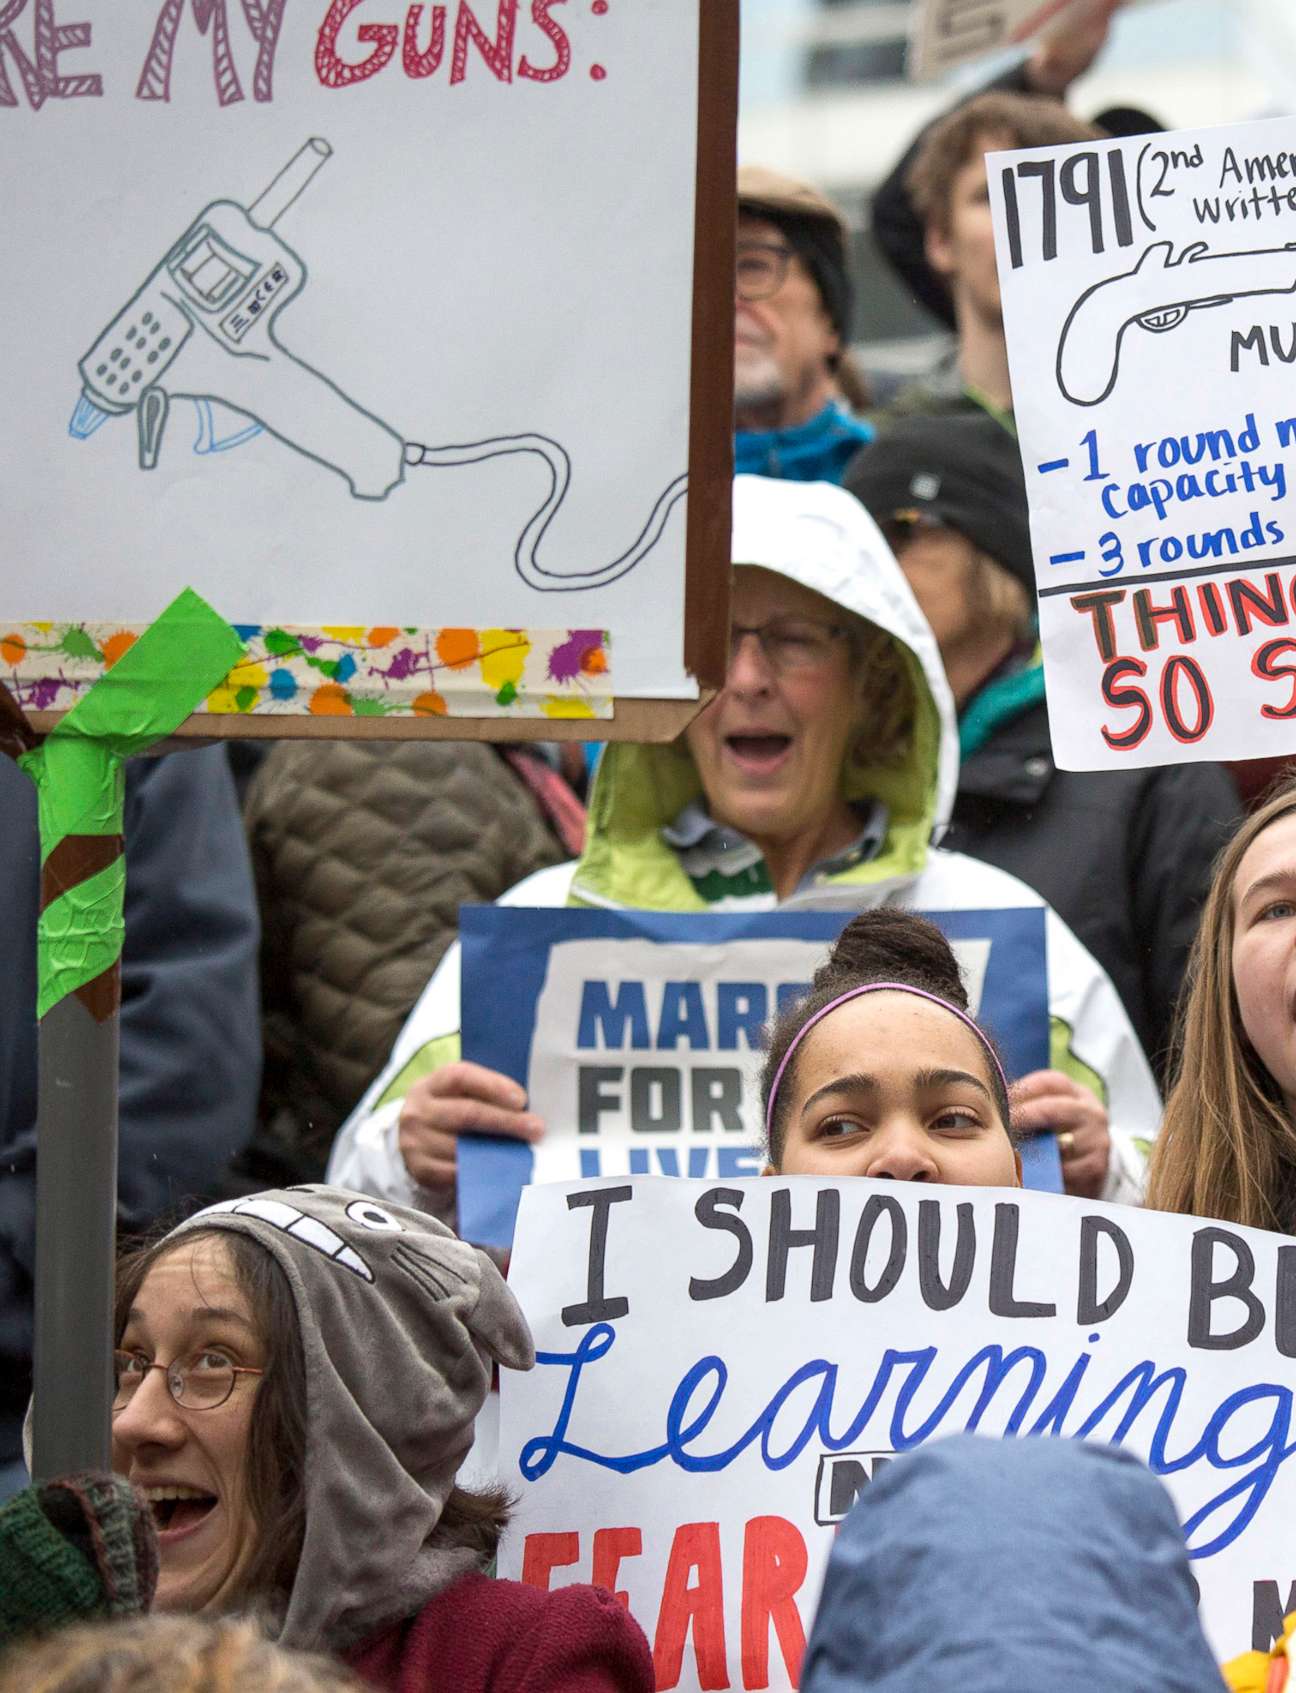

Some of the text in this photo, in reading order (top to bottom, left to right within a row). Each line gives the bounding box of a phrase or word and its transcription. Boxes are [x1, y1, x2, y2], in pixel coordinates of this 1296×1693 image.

[136, 0, 286, 107] MY
[315, 0, 608, 88] GUNS:
[1002, 148, 1134, 269] 1791
[1134, 413, 1261, 475] round
[1101, 460, 1287, 520] capacity
[1138, 512, 1285, 568] rounds
[1100, 654, 1215, 751] SO
[578, 1066, 745, 1133] FOR
[561, 1185, 632, 1325] I
[688, 1188, 1134, 1326] SHOULD
